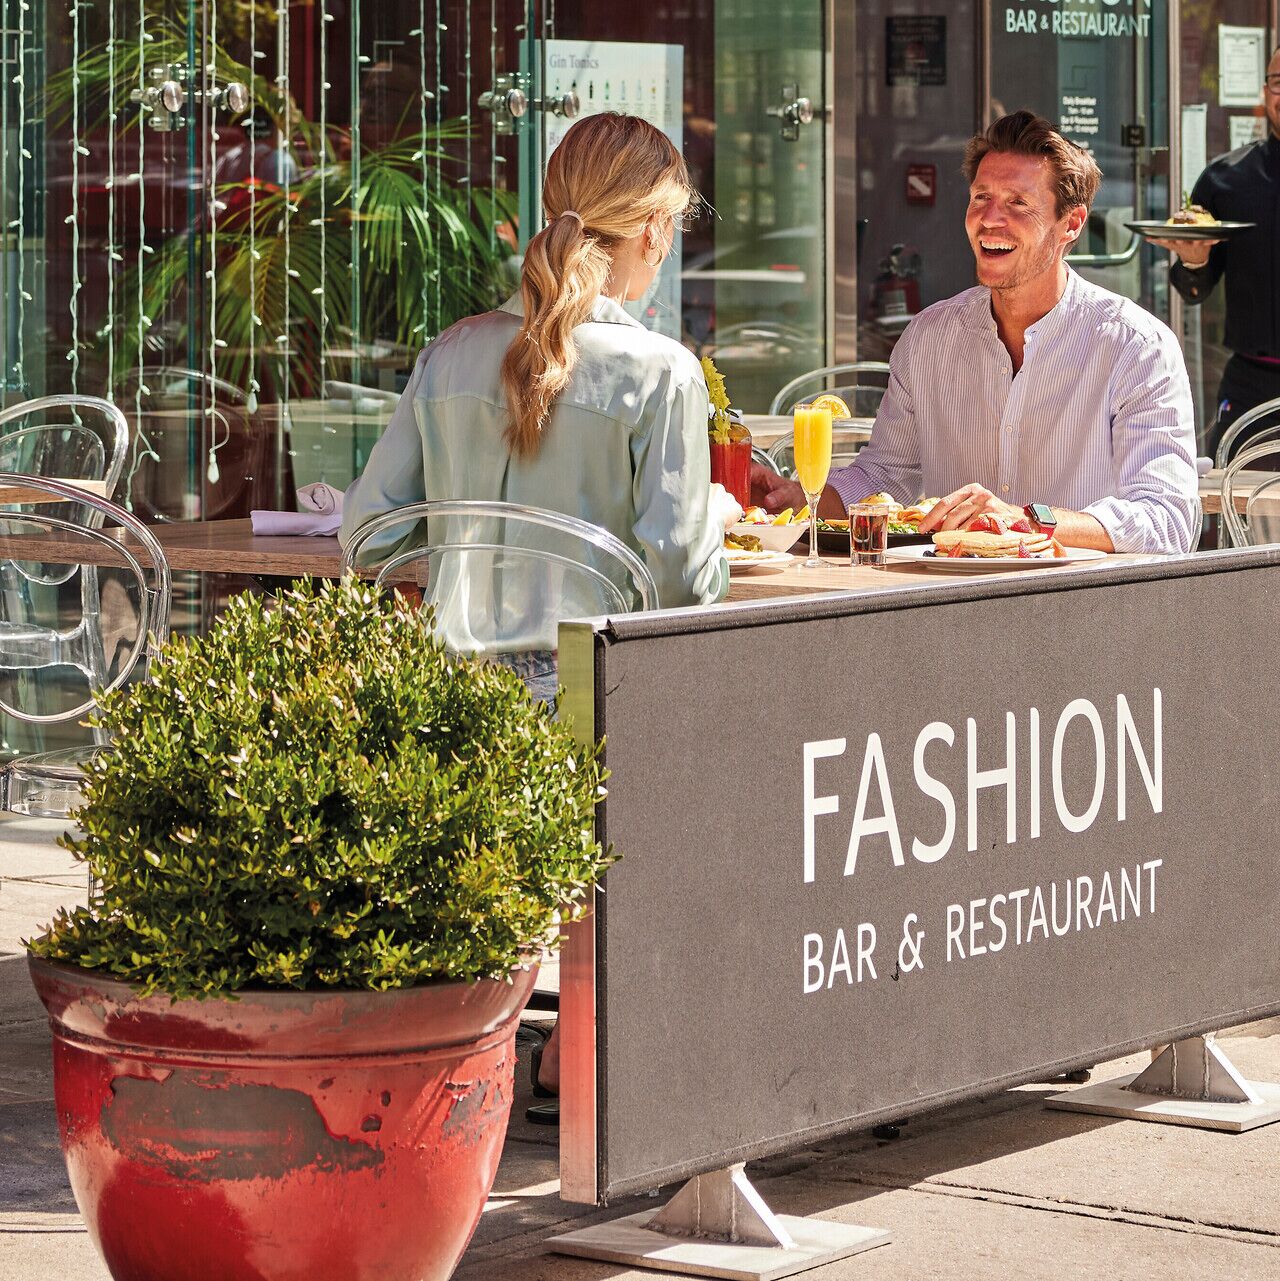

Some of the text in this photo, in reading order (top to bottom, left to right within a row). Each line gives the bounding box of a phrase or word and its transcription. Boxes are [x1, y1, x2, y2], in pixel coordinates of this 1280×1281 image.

[549, 53, 600, 70] Gin Tonics
[1005, 8, 1151, 37] BAR & RESTAURANT
[803, 687, 1164, 884] FASHION
[803, 858, 1164, 995] BAR & RESTAURANT
